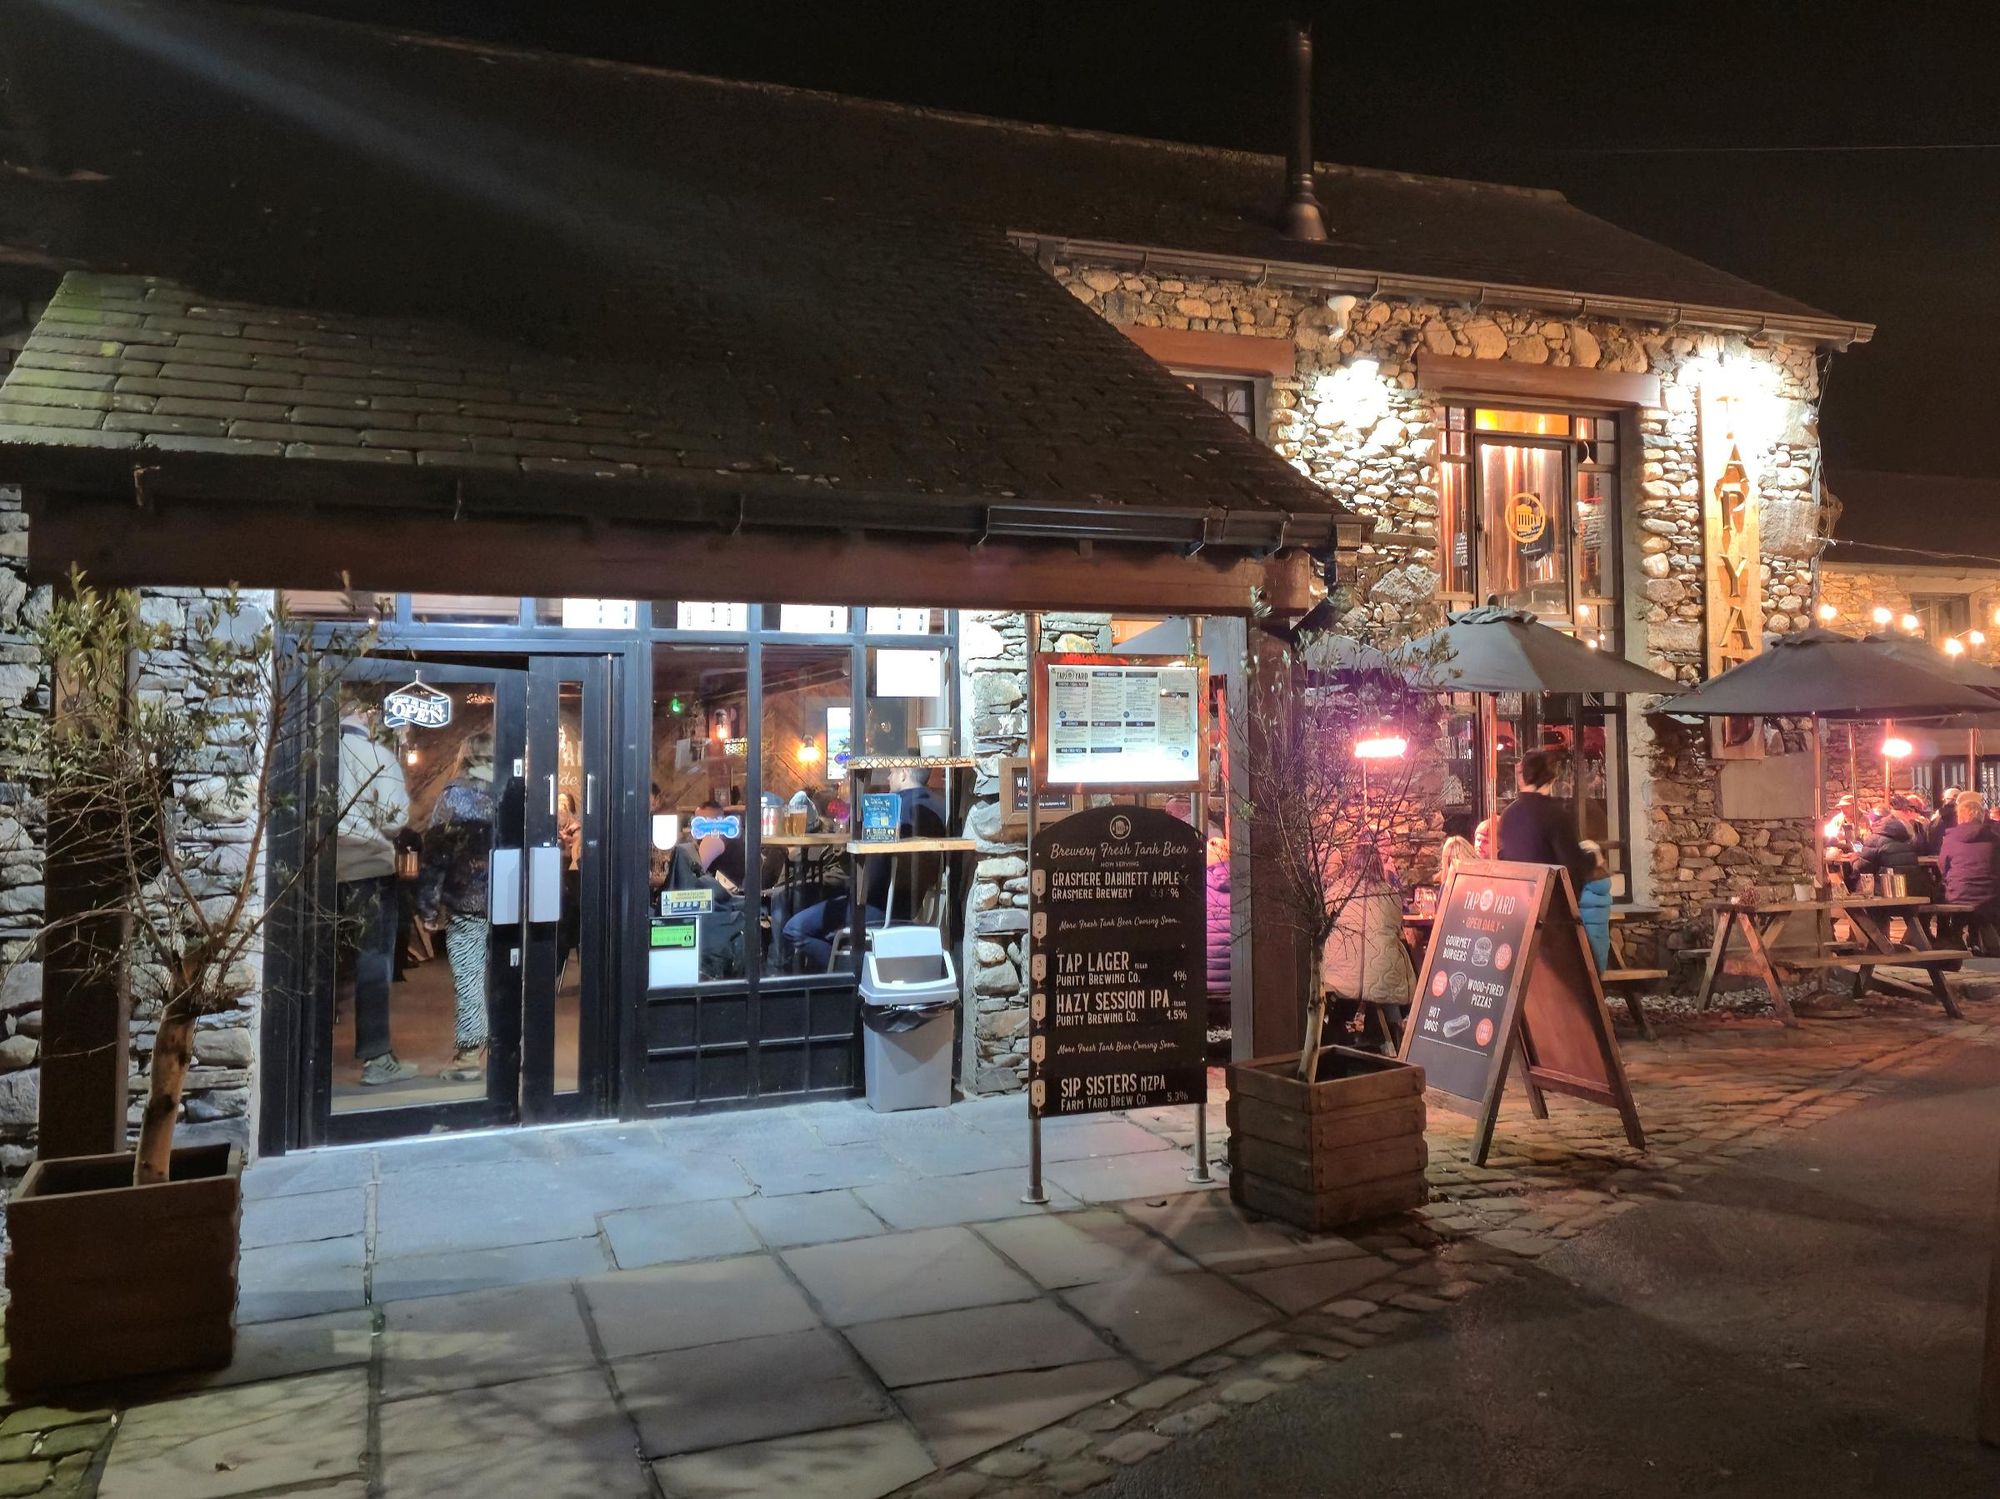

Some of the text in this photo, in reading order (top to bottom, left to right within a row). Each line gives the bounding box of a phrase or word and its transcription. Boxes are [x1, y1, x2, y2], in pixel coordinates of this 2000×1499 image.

[391, 703, 444, 723] OPEN
[1050, 841, 1188, 861] Brewery Fresh Tank Beer
[1052, 871, 1180, 886] GRASMERE DABINETT APPLE
[1052, 888, 1093, 900] GRASMERE
[1096, 888, 1133, 899] BREWERY
[1463, 890, 1516, 915] TAP YARD
[1059, 921, 1077, 931] More
[1079, 919, 1098, 929] Fresh
[1099, 918, 1115, 929] Tank
[1118, 917, 1132, 927] Beer
[1134, 916, 1159, 928] Coming
[1465, 916, 1500, 933] OPEN DAILY
[1445, 934, 1472, 949] GOURMET
[1056, 953, 1083, 973] TAP
[1088, 951, 1129, 972] LAGER
[1442, 948, 1468, 962] BURGERS
[1056, 974, 1085, 987] PURITY
[1088, 973, 1125, 985] BREWING
[1467, 978, 1505, 997] WOOD-FIRED
[1056, 993, 1090, 1013] HAZY
[1095, 990, 1145, 1011] SESSION
[1150, 989, 1170, 1008] IPA
[1470, 994, 1493, 1009] PIZZAS
[1056, 1014, 1084, 1027] PURITY
[1087, 1012, 1123, 1025] BREWING
[1166, 1010, 1187, 1020] 4.5%
[1428, 1005, 1441, 1018] HOT
[1423, 1019, 1439, 1033] DOGS
[1057, 1045, 1076, 1055] More
[1077, 1044, 1096, 1053] Fresh
[1098, 1042, 1115, 1053] Tank
[1115, 1041, 1131, 1052] Beer
[1132, 1040, 1158, 1053] Coming
[1061, 1073, 1166, 1098] SIP SISTERS NZPA
[1060, 1098, 1084, 1112] FARM
[1087, 1096, 1108, 1109] YARD
[1110, 1094, 1133, 1107] BREW
[1167, 1091, 1189, 1102] 5.3%
